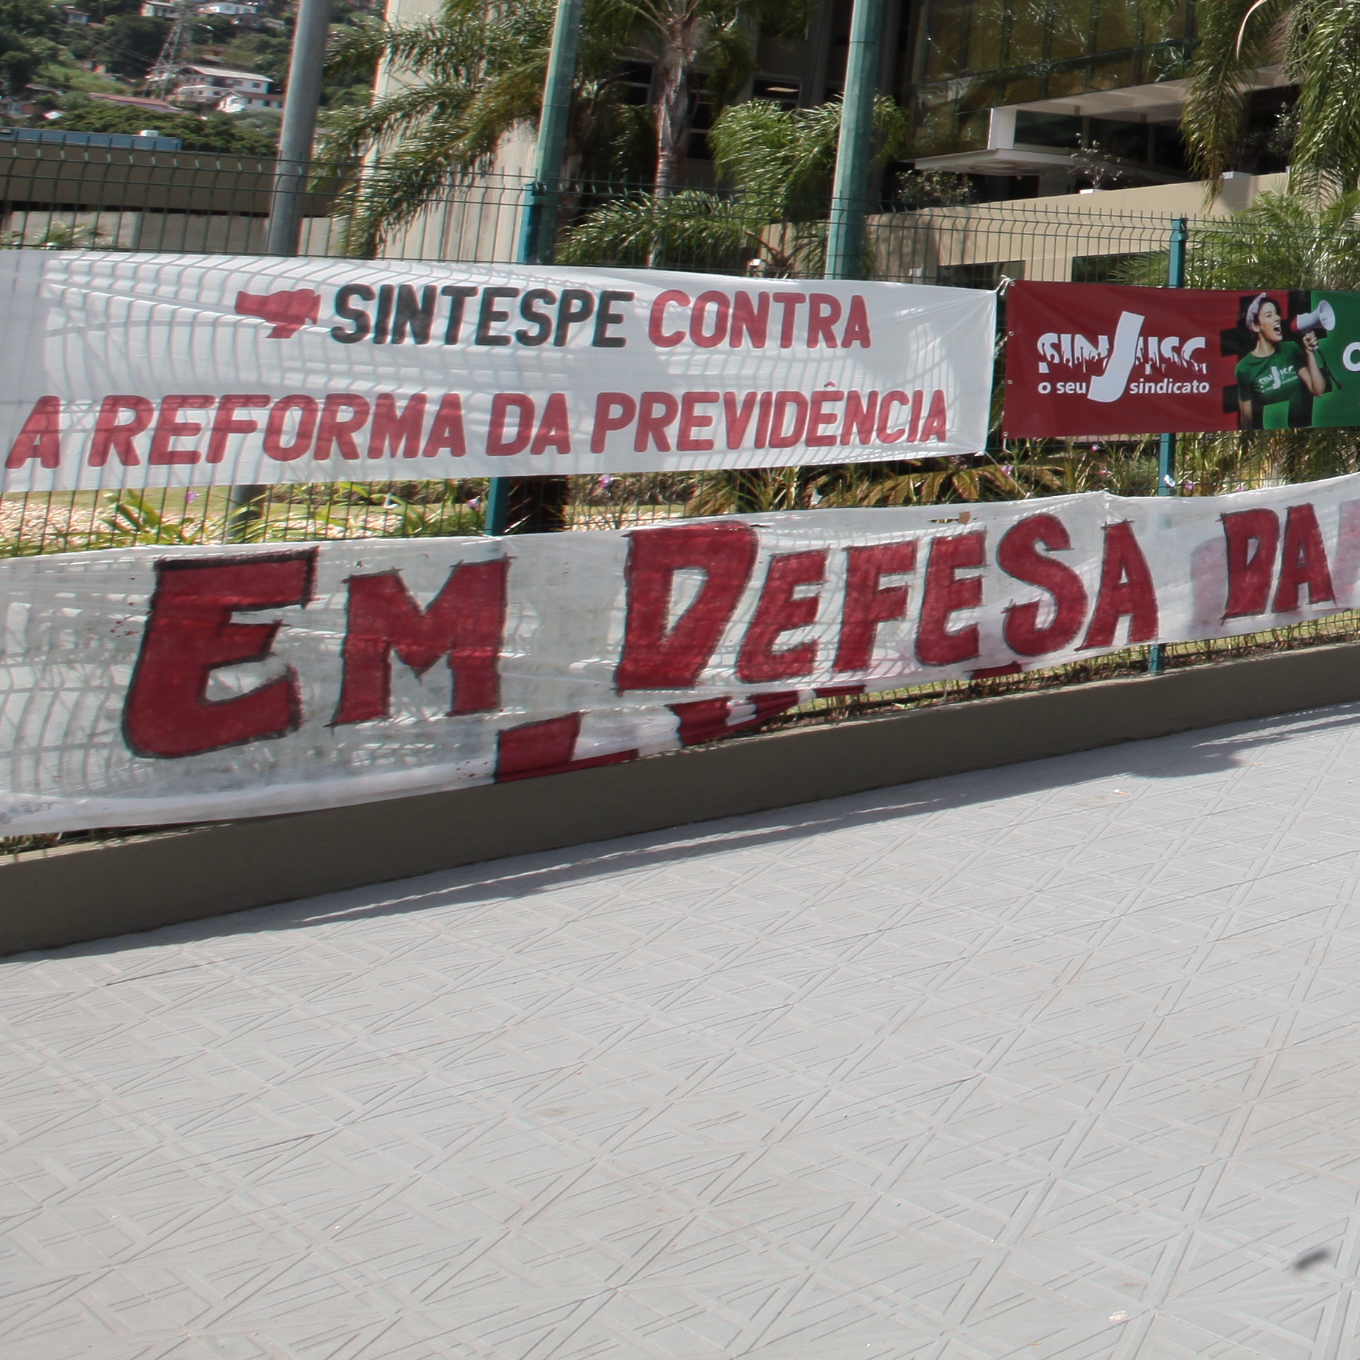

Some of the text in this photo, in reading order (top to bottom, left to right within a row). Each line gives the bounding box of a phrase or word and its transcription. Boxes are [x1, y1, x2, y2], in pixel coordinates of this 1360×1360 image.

[330, 286, 872, 349] SINTESPE CONTRA
[1038, 377, 1210, 395] o seu sindicato
[4, 382, 948, 470] A REFORMA DA PREVIDÊNCIA
[123, 548, 508, 758] EM
[616, 513, 1159, 694] DEFESA
[1222, 502, 1335, 625] DA
